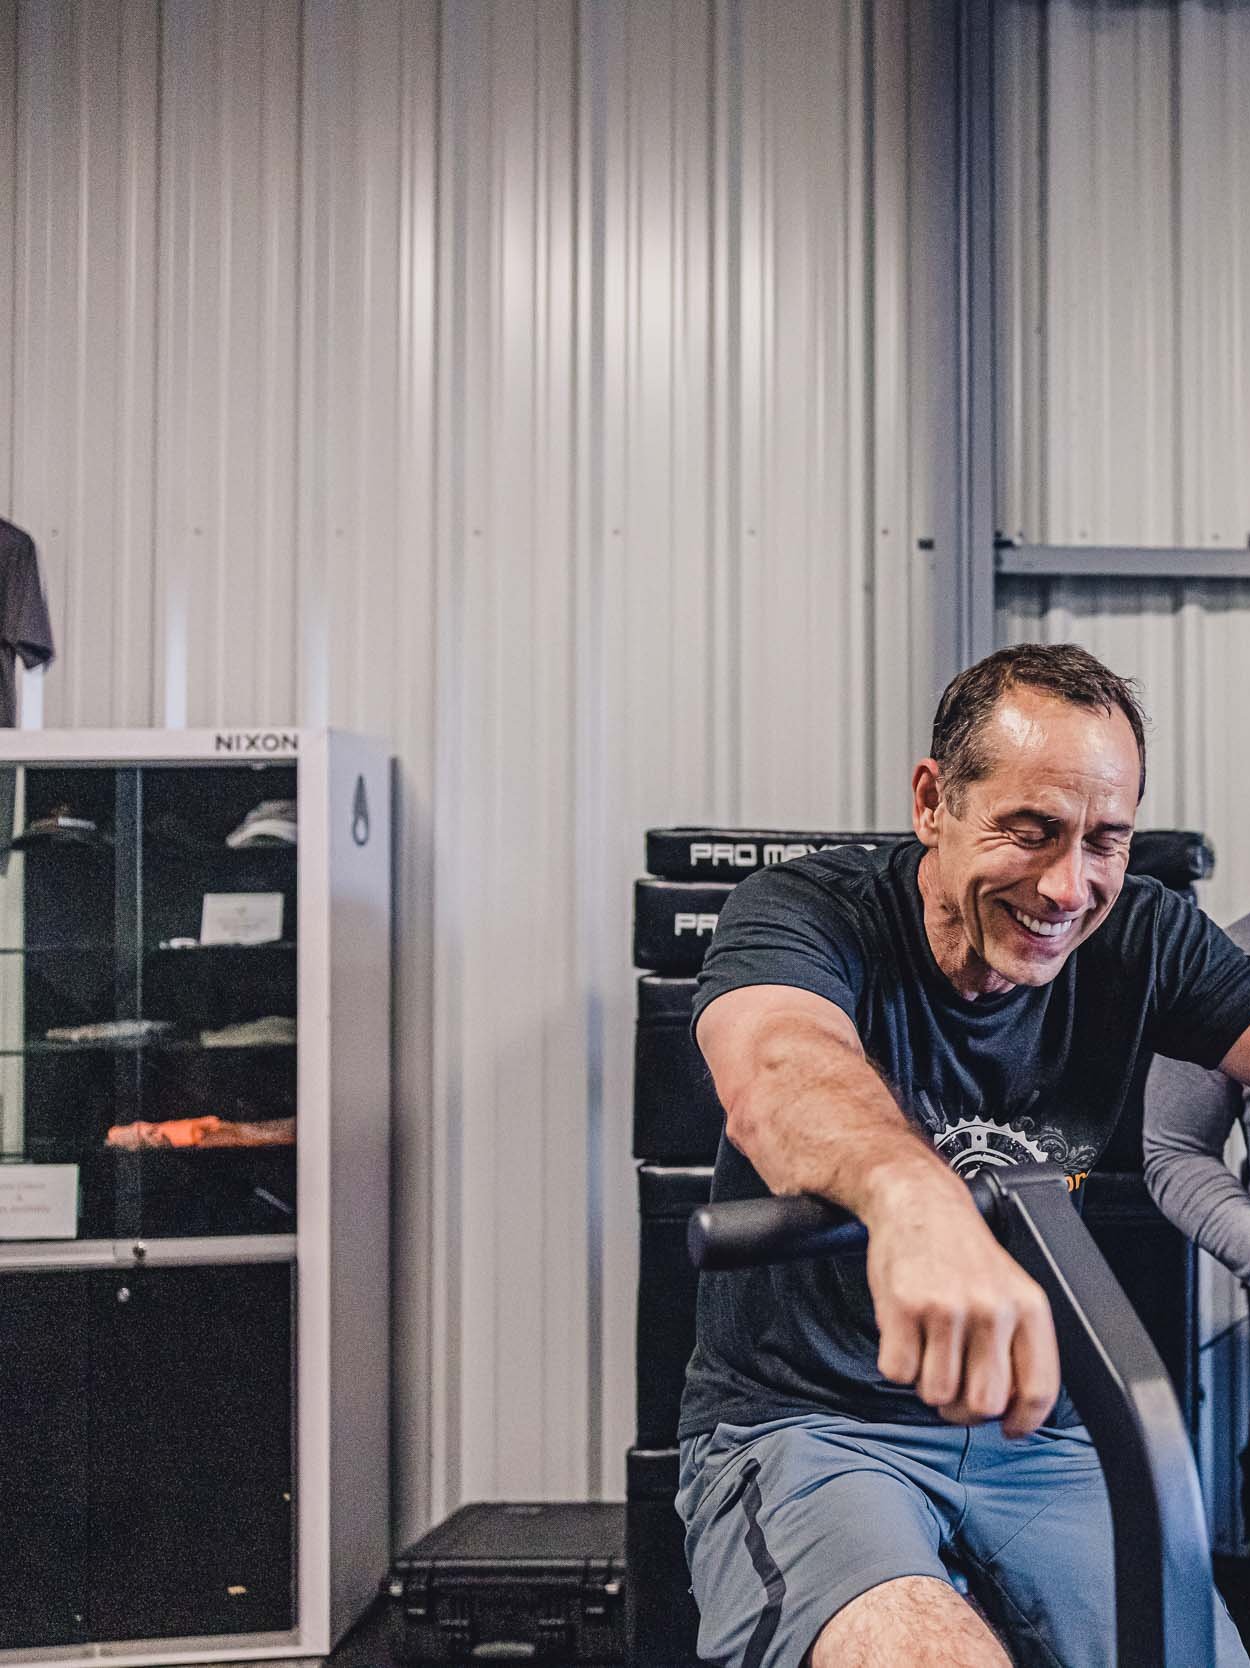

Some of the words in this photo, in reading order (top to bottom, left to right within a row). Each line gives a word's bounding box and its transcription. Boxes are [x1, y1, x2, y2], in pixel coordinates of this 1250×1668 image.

[214, 733, 299, 752] NIXON
[689, 842, 758, 867] PRO
[674, 912, 719, 937] PR
